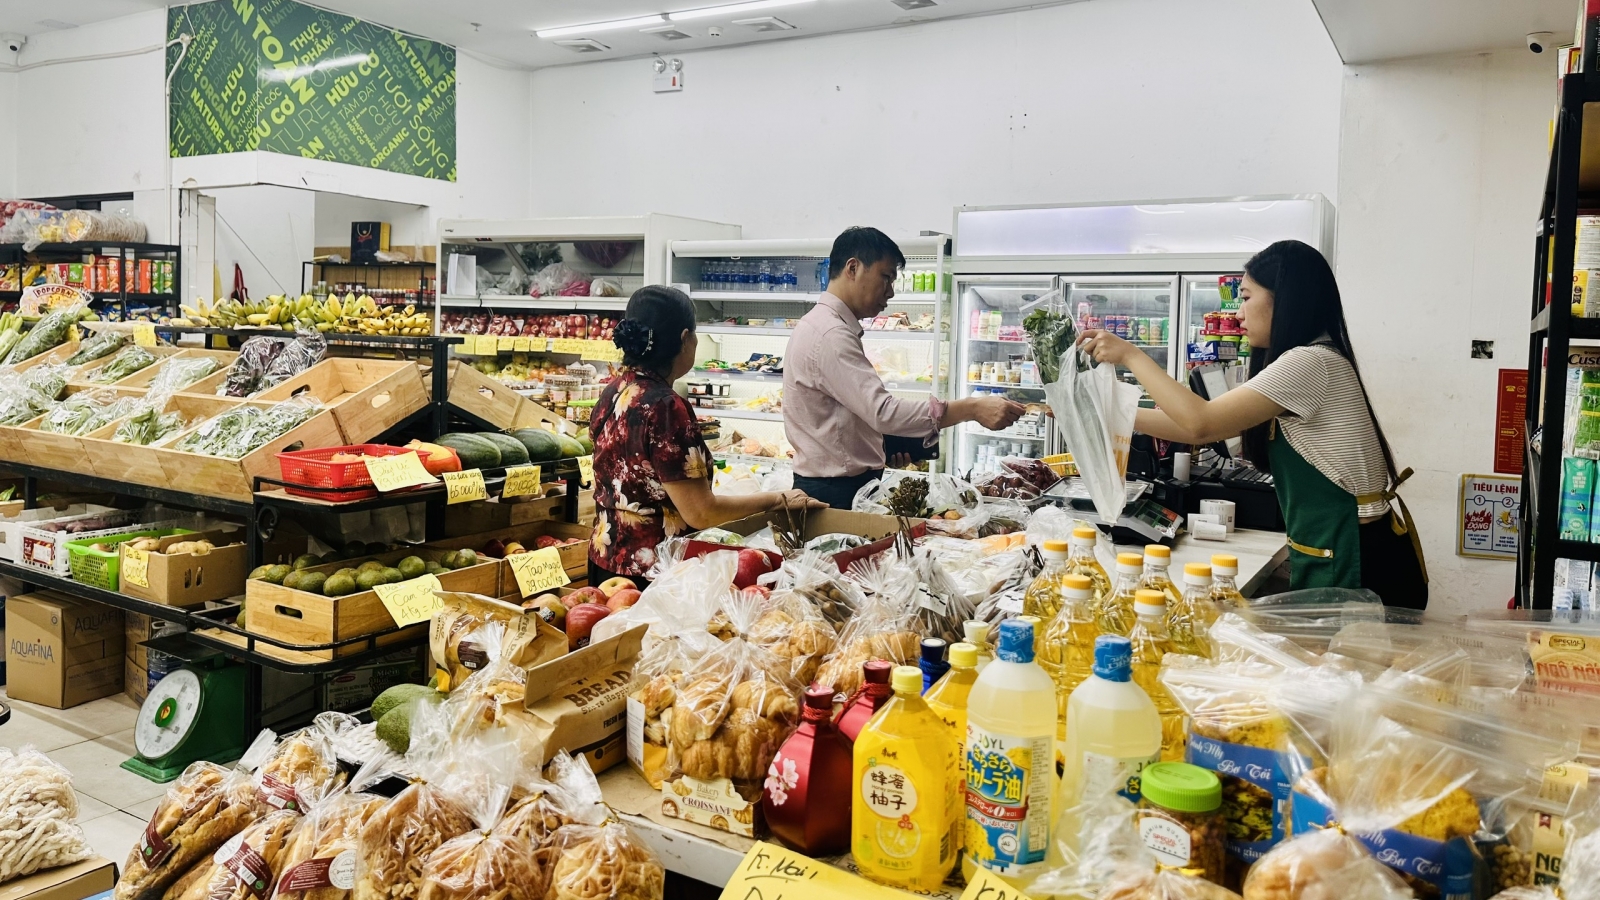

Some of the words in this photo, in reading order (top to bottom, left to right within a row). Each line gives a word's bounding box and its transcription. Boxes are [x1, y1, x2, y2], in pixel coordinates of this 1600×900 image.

[289, 22, 321, 52] THỰC
[325, 70, 359, 107] HỮU
[358, 48, 380, 77] CƠ
[190, 87, 226, 143] NATURE
[270, 94, 296, 125] CƠ
[370, 127, 410, 168] ORGANIC
[36, 286, 74, 298] POPCORN
[1473, 482, 1492, 492] TIÊU
[1495, 483, 1519, 495] LỆNH
[525, 561, 543, 577] Táo
[393, 593, 417, 607] Cam
[10, 638, 56, 663] AQUAFINA
[563, 670, 632, 708] BREAD
[696, 782, 719, 798] Bakery
[871, 770, 905, 790] 蜂蜜
[682, 796, 732, 817] CROISSANT
[870, 790, 907, 811] 柚子
[1166, 826, 1187, 856] QUALITY
